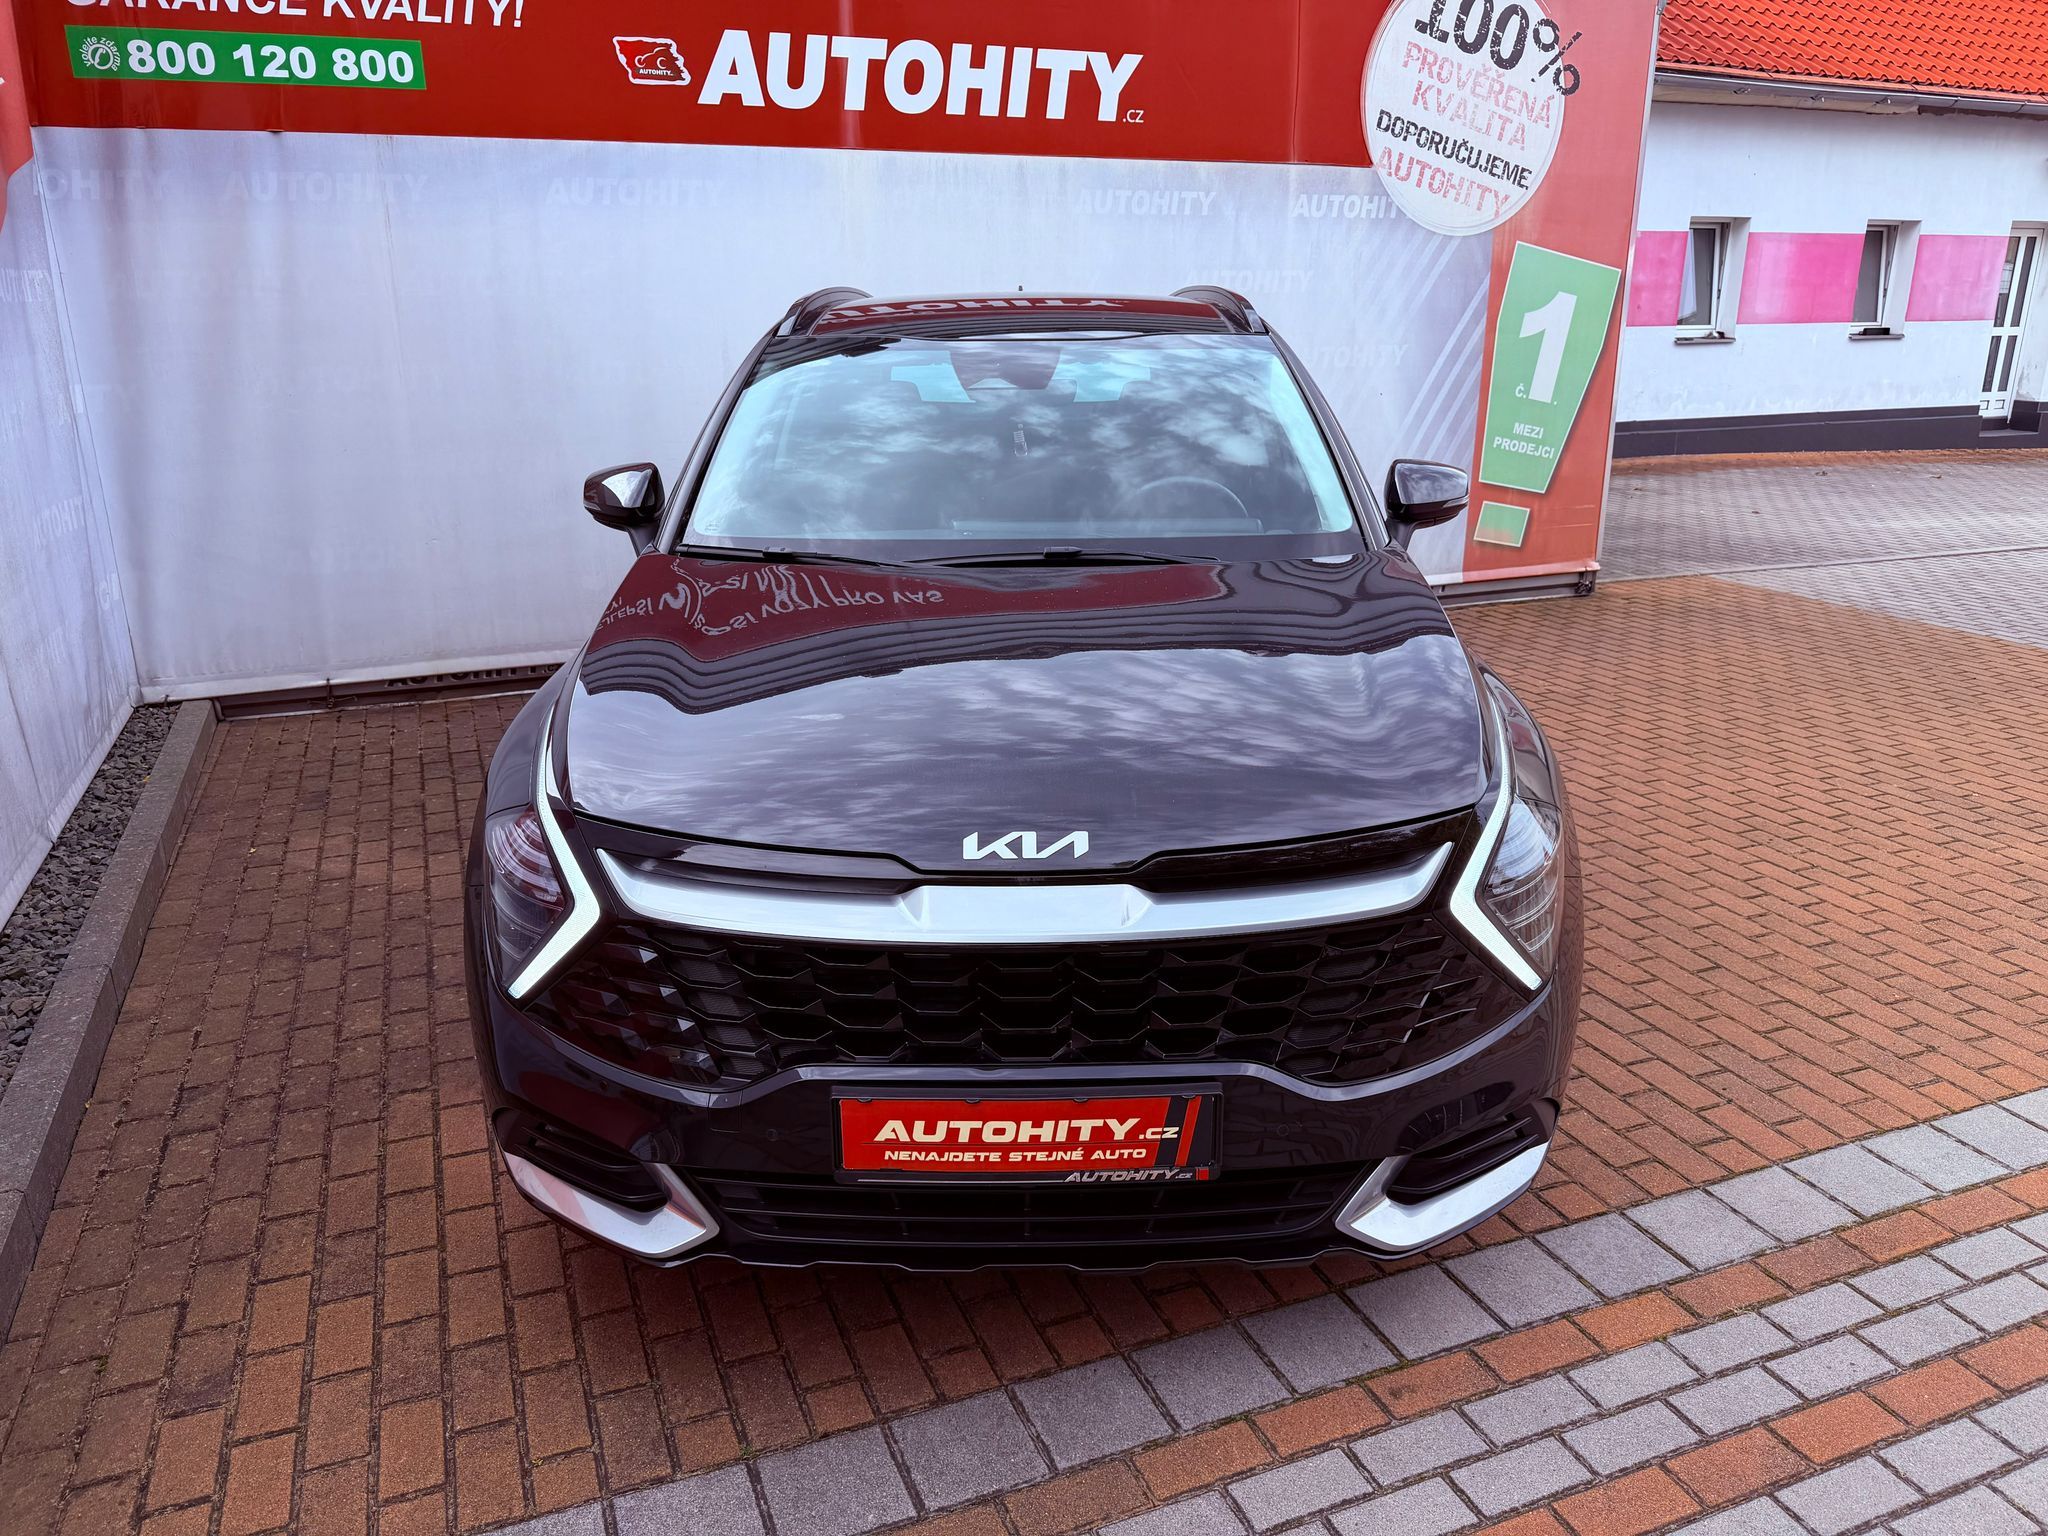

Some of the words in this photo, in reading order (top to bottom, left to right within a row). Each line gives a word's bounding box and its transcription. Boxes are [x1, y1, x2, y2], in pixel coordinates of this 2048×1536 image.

[127, 39, 216, 76] 800
[232, 43, 317, 79] 120
[332, 48, 415, 83] 800
[1414, 0, 1583, 96] 100%
[1402, 41, 1555, 128] PROVĚŘENÁ
[1412, 80, 1526, 151] KVALITA
[1376, 109, 1533, 191] DOPORUČUJEME
[1376, 146, 1511, 219] AUTOHITY
[1075, 190, 1217, 216] AUTOHITY
[1493, 436, 1555, 459] PRODEJCI
[1513, 422, 1544, 439] MEZI
[963, 831, 1089, 860] KIA
[874, 1117, 1180, 1144] AUTOHITY.cz
[884, 1149, 1002, 1162] NENAJDETE
[1009, 1147, 1083, 1162] STEJNÉ
[1090, 1148, 1147, 1160] AUTO
